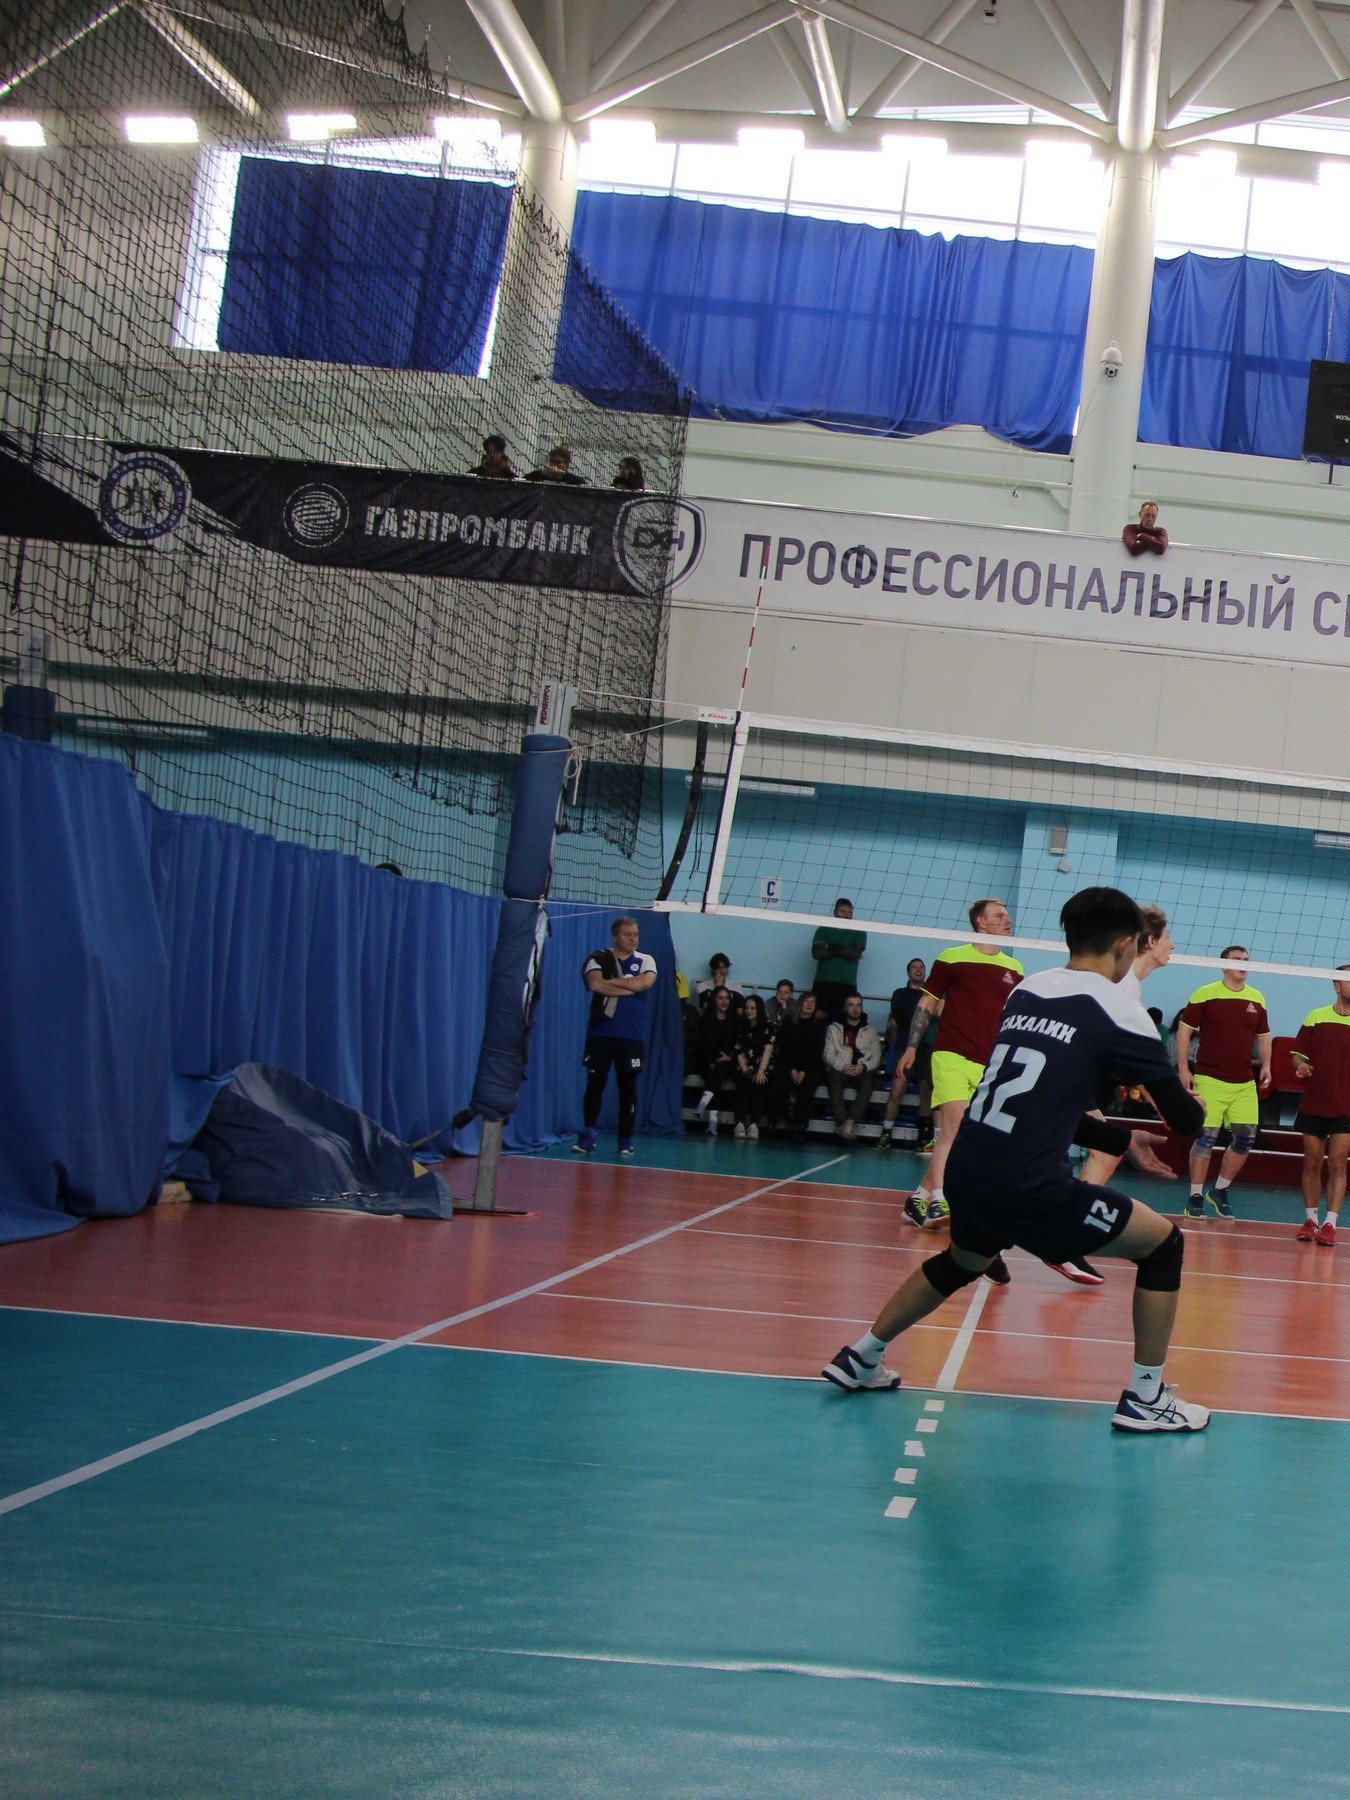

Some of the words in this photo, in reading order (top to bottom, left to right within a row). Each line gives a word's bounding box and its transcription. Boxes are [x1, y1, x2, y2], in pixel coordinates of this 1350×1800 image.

[363, 504, 592, 556] ГАЗПРОМБАНК
[738, 532, 1295, 632] ПРОФЕССИОНАЛЬНЫЙ
[969, 1044, 1046, 1133] 12
[1083, 1200, 1119, 1232] 12
